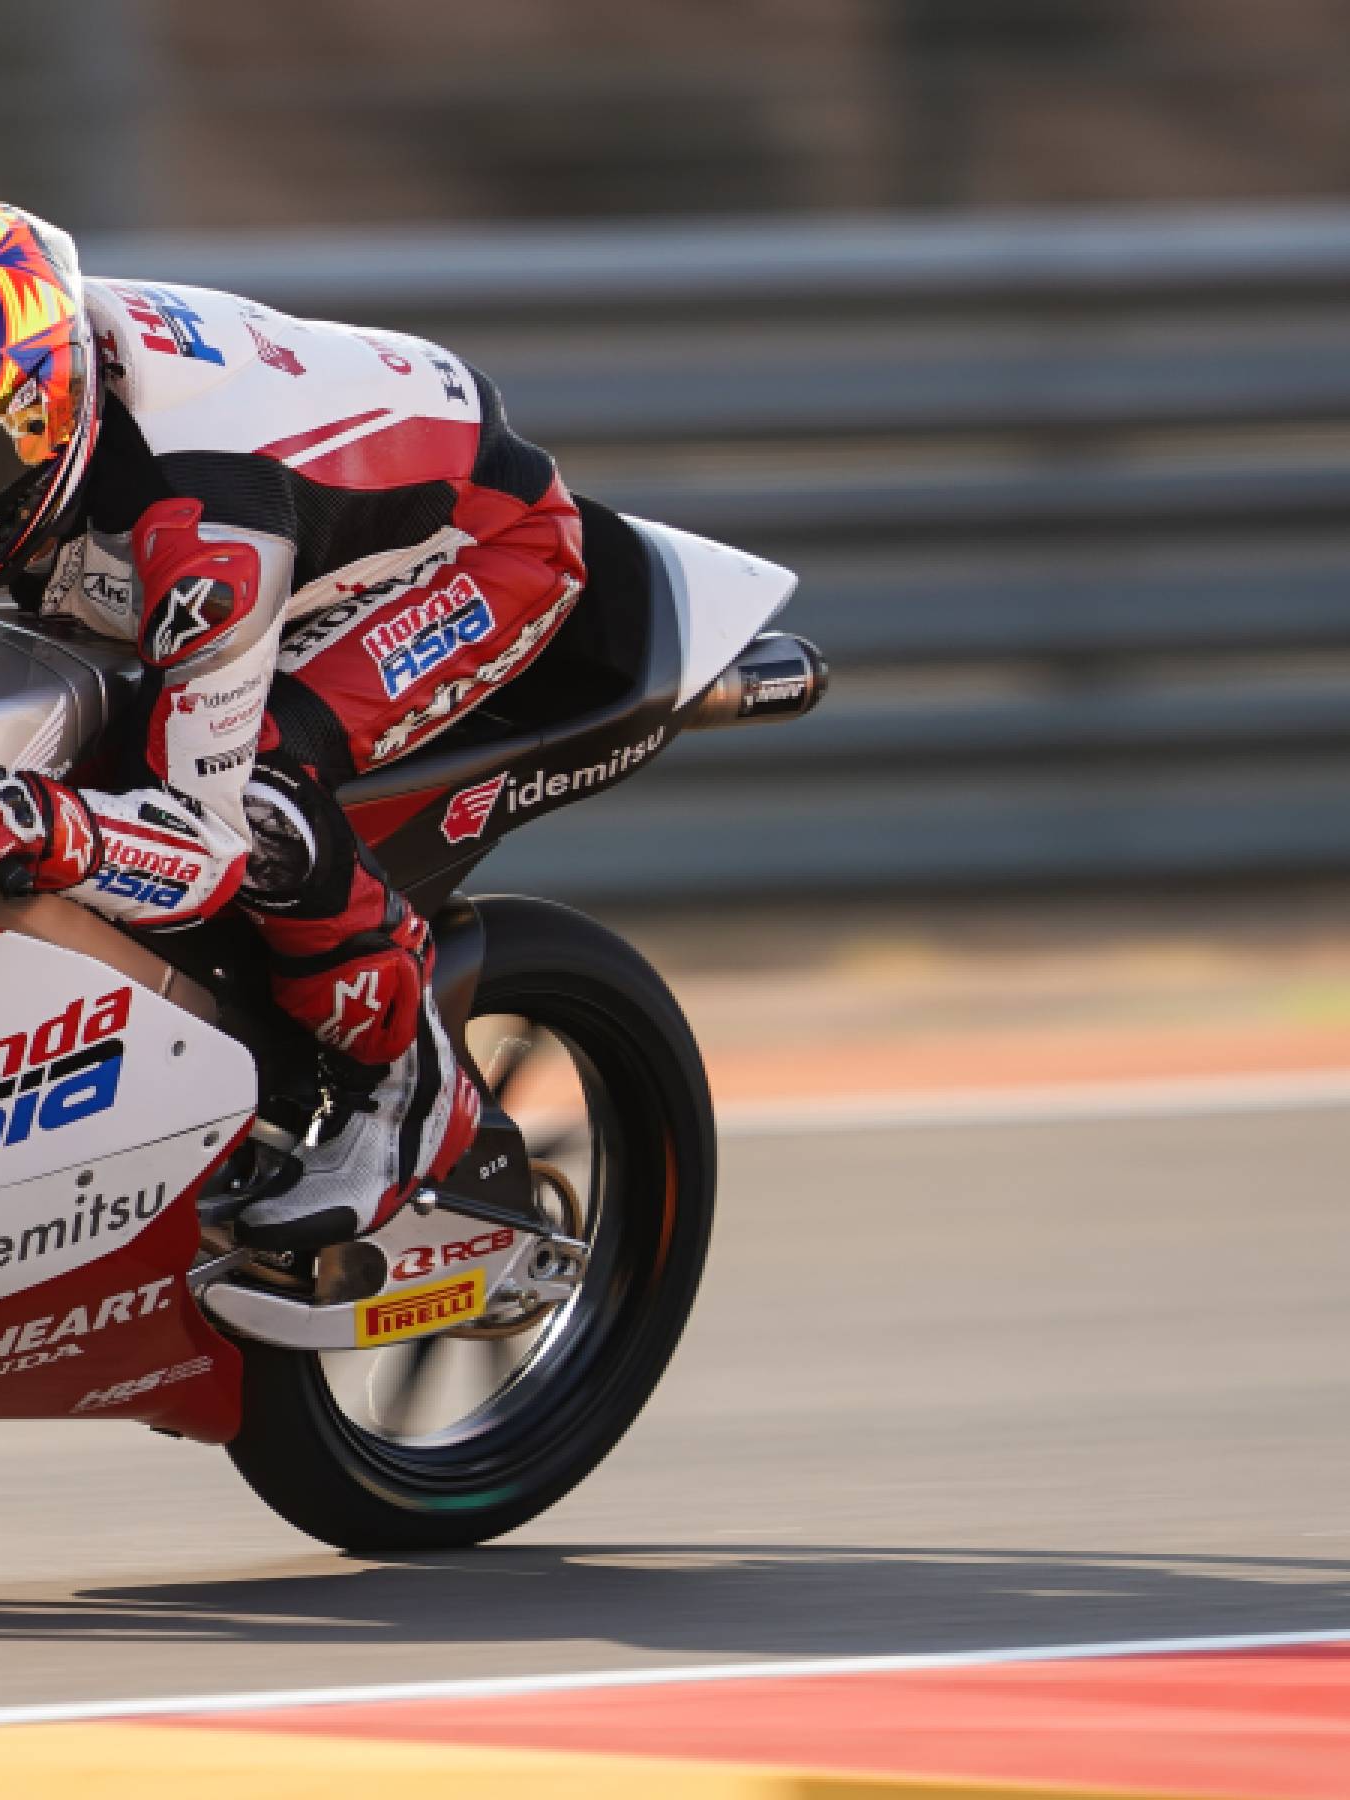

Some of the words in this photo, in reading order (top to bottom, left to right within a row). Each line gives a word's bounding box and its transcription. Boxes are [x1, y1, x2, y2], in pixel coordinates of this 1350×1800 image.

[507, 725, 665, 813] idemitsu
[441, 1228, 515, 1266] RCB
[365, 1280, 476, 1337] PIRELLI
